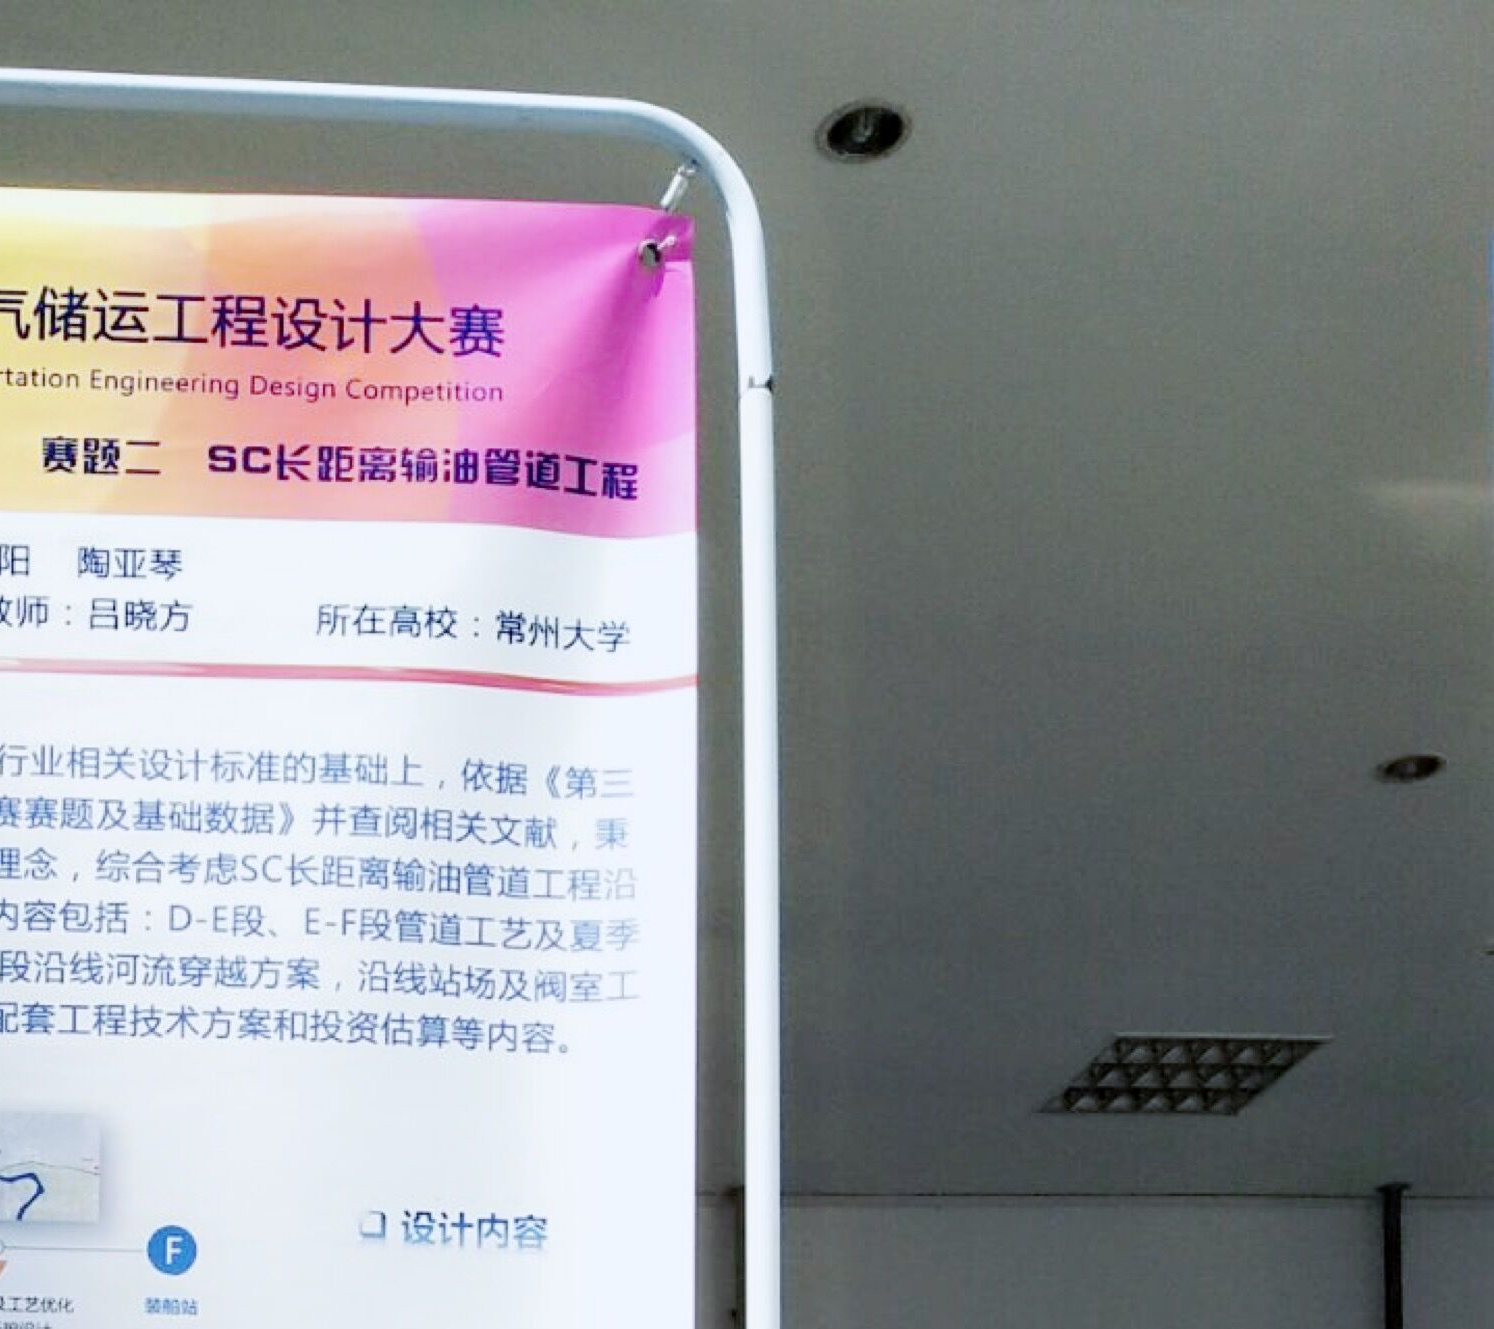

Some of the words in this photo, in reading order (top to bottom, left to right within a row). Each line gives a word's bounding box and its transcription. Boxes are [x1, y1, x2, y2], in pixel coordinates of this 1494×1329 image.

[90, 370, 240, 401] Engineering
[250, 374, 337, 404] Design
[346, 377, 504, 407] Competition
[42, 436, 162, 477] 赛题二
[207, 441, 639, 502] SC长距离输油管道工程
[76, 546, 183, 582] 陶亚琴
[315, 603, 631, 654] 所在高校：常州大学
[401, 1210, 550, 1249] 设计内容
[164, 1235, 184, 1265] F
